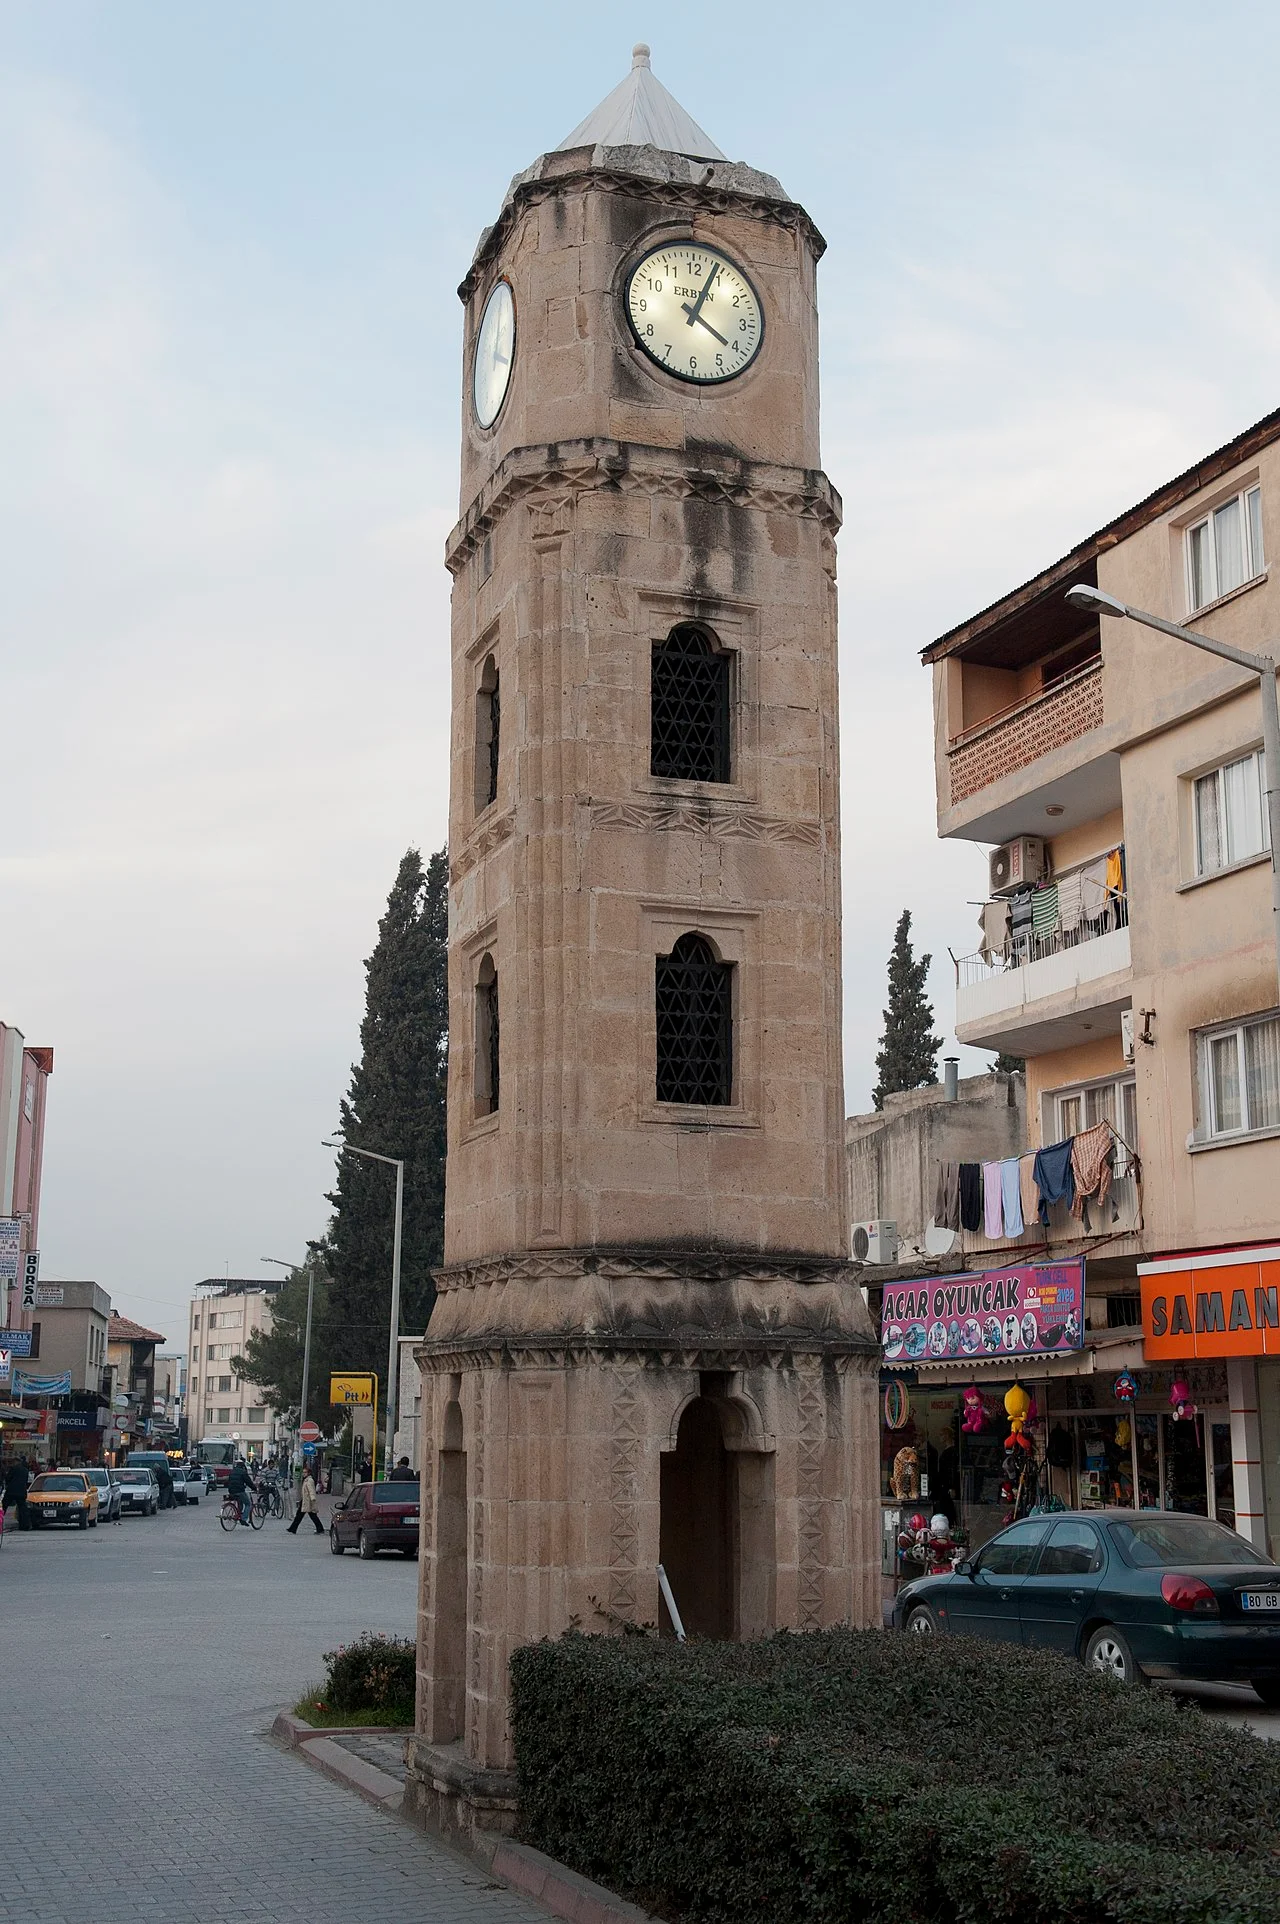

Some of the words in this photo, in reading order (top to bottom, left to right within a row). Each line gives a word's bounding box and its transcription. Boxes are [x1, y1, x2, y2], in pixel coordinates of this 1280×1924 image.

[664, 264, 678, 278] 11
[686, 262, 702, 276] 12
[647, 278, 663, 292] 10
[715, 275, 721, 287] 1
[639, 299, 647, 312] 9
[732, 295, 740, 308] 2
[646, 323, 654, 337] 8
[739, 318, 747, 331] 3
[664, 344, 673, 357] 7
[731, 340, 740, 353] 4
[689, 356, 697, 369] 6
[715, 353, 723, 366] 5
[23, 1255, 37, 1305] BORSA
[883, 1288, 929, 1322] ACAR
[932, 1276, 1021, 1319] OYUNCAK
[1056, 1288, 1074, 1302] avea
[1152, 1286, 1279, 1337] SAMAN
[1, 1351, 9, 1360] Y
[345, 1391, 359, 1402] Ptt
[1249, 1595, 1261, 1607] 80
[1266, 1595, 1278, 1607] GB
